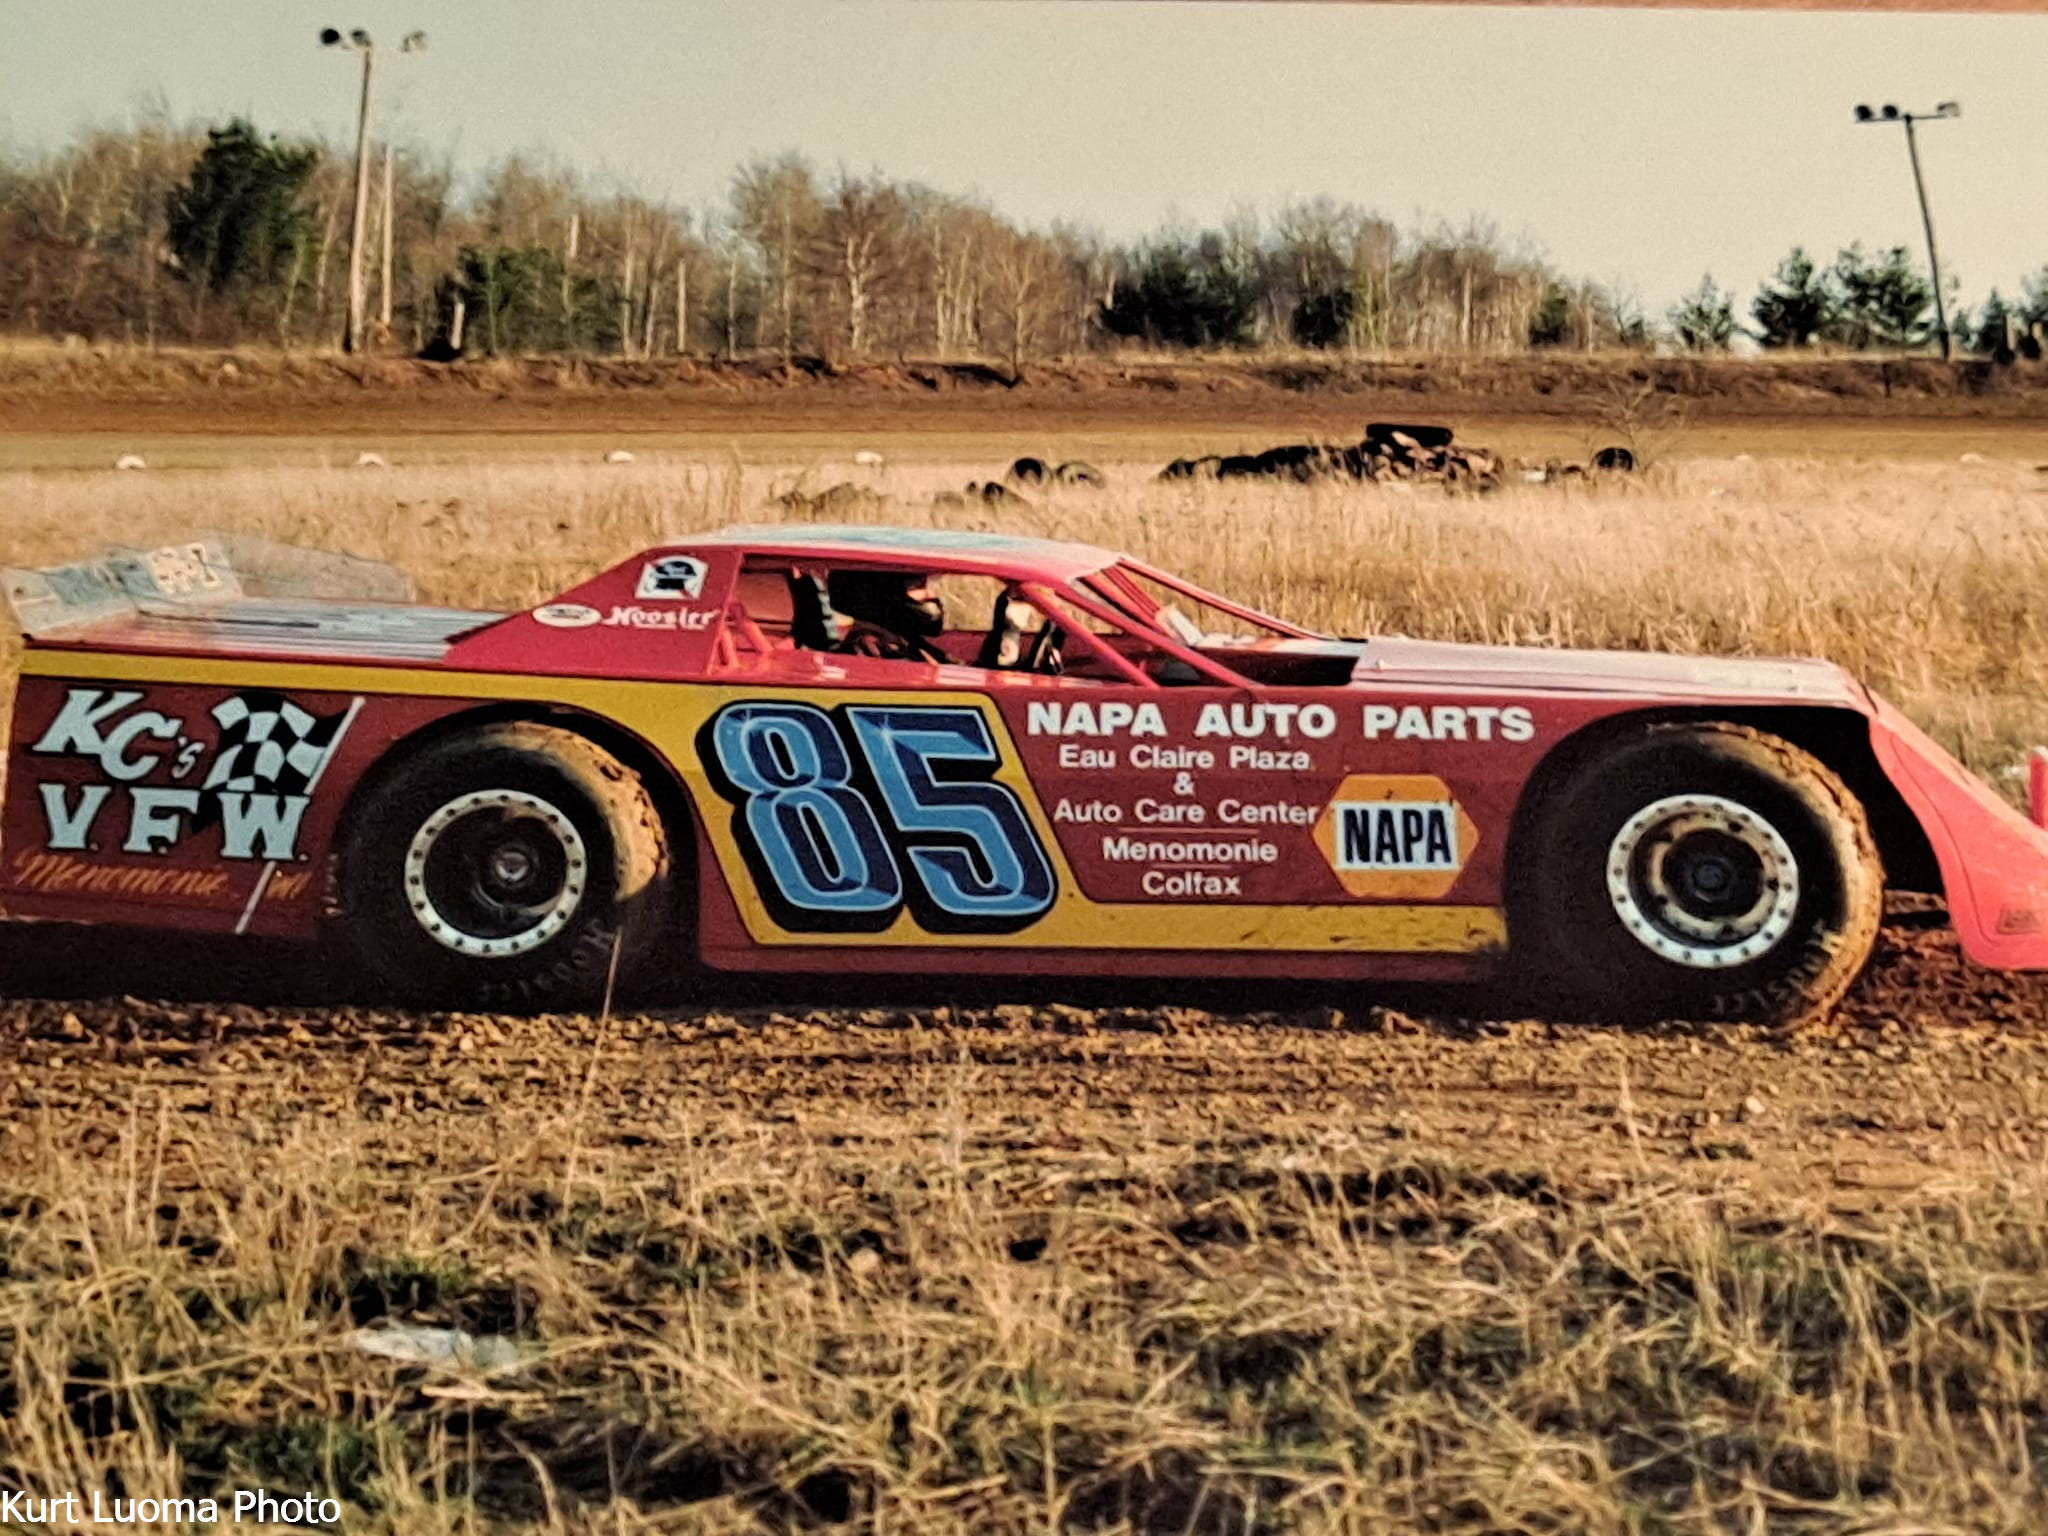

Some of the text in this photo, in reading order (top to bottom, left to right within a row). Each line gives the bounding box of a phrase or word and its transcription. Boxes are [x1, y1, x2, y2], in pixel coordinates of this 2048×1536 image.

[31, 688, 205, 780] KC's
[1027, 701, 1535, 741] NAPA AUTO PARTS
[1059, 744, 1310, 770] Eau Claire Plaza
[1173, 771, 1195, 796] &
[708, 702, 1058, 924] 85
[1053, 799, 1319, 825] Auto Care Center
[1102, 836, 1278, 862] Menomonie
[1343, 808, 1452, 864] NAPA
[1142, 870, 1241, 896] Colfax
